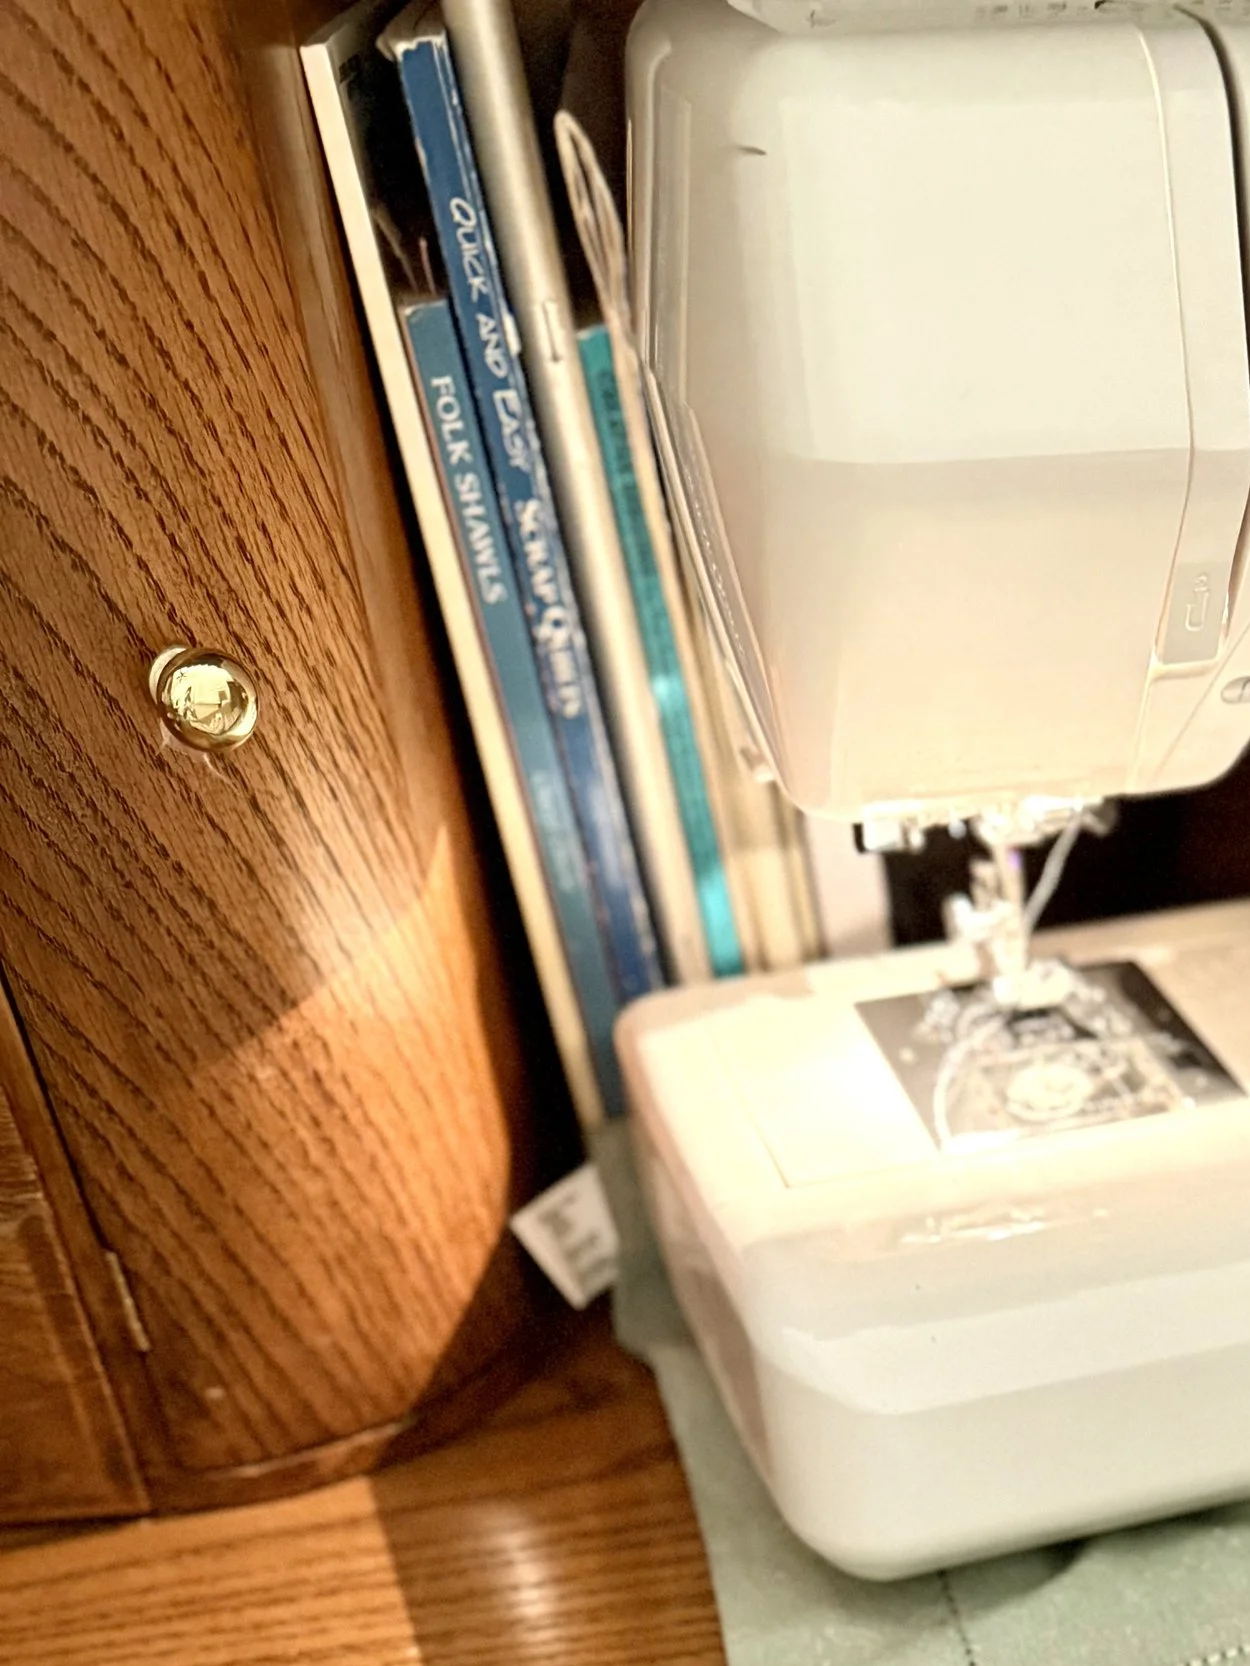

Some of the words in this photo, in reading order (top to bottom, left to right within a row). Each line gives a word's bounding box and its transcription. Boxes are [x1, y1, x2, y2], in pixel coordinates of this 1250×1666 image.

[450, 197, 490, 302] QUICK
[476, 313, 508, 378] AND
[430, 375, 473, 465] FOLK
[454, 472, 508, 605] SHAWLS
